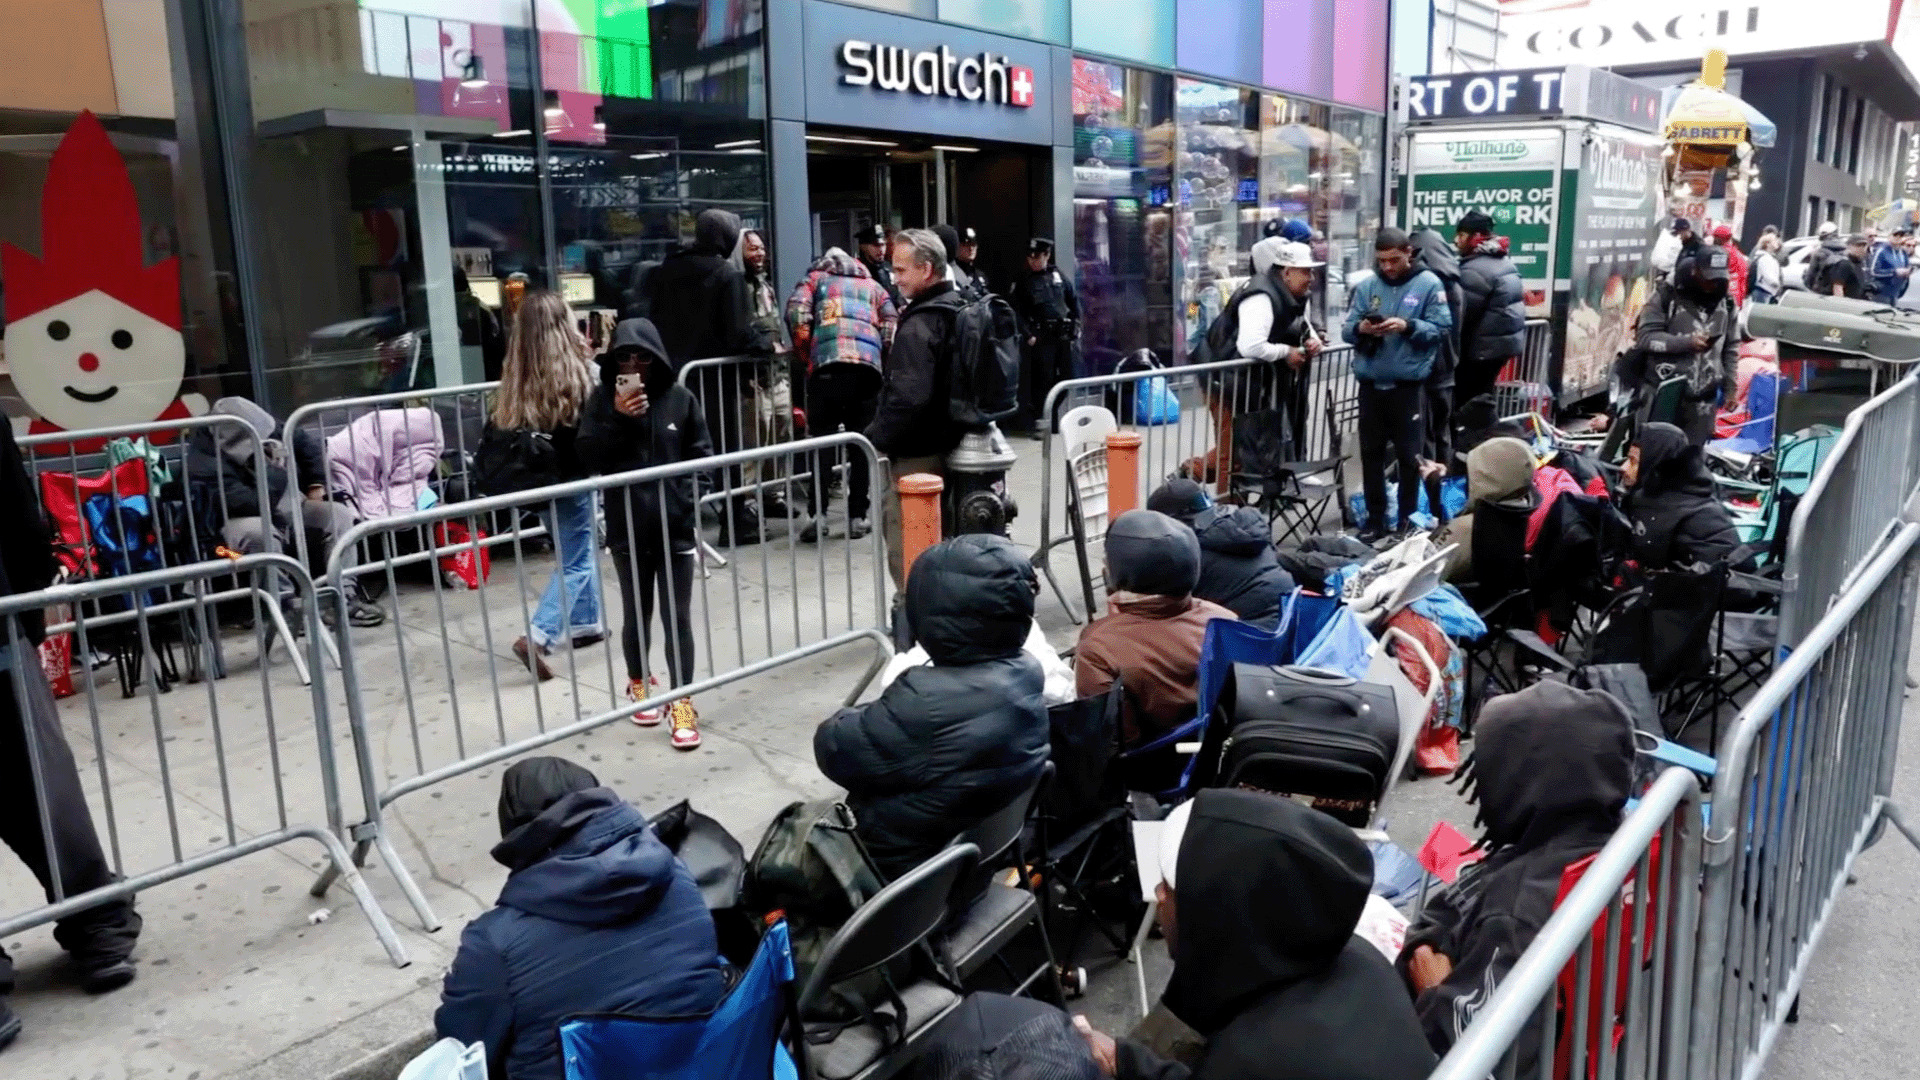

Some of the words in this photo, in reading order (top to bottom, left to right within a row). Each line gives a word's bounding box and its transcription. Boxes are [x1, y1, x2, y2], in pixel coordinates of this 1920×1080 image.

[843, 40, 1008, 104] swatch
[1463, 76, 1519, 113] OF
[1533, 72, 1565, 110] T
[1414, 190, 1448, 204] THE
[1452, 188, 1523, 204] FLAVOR
[1527, 187, 1553, 202] OF
[1413, 206, 1472, 226] NEW
